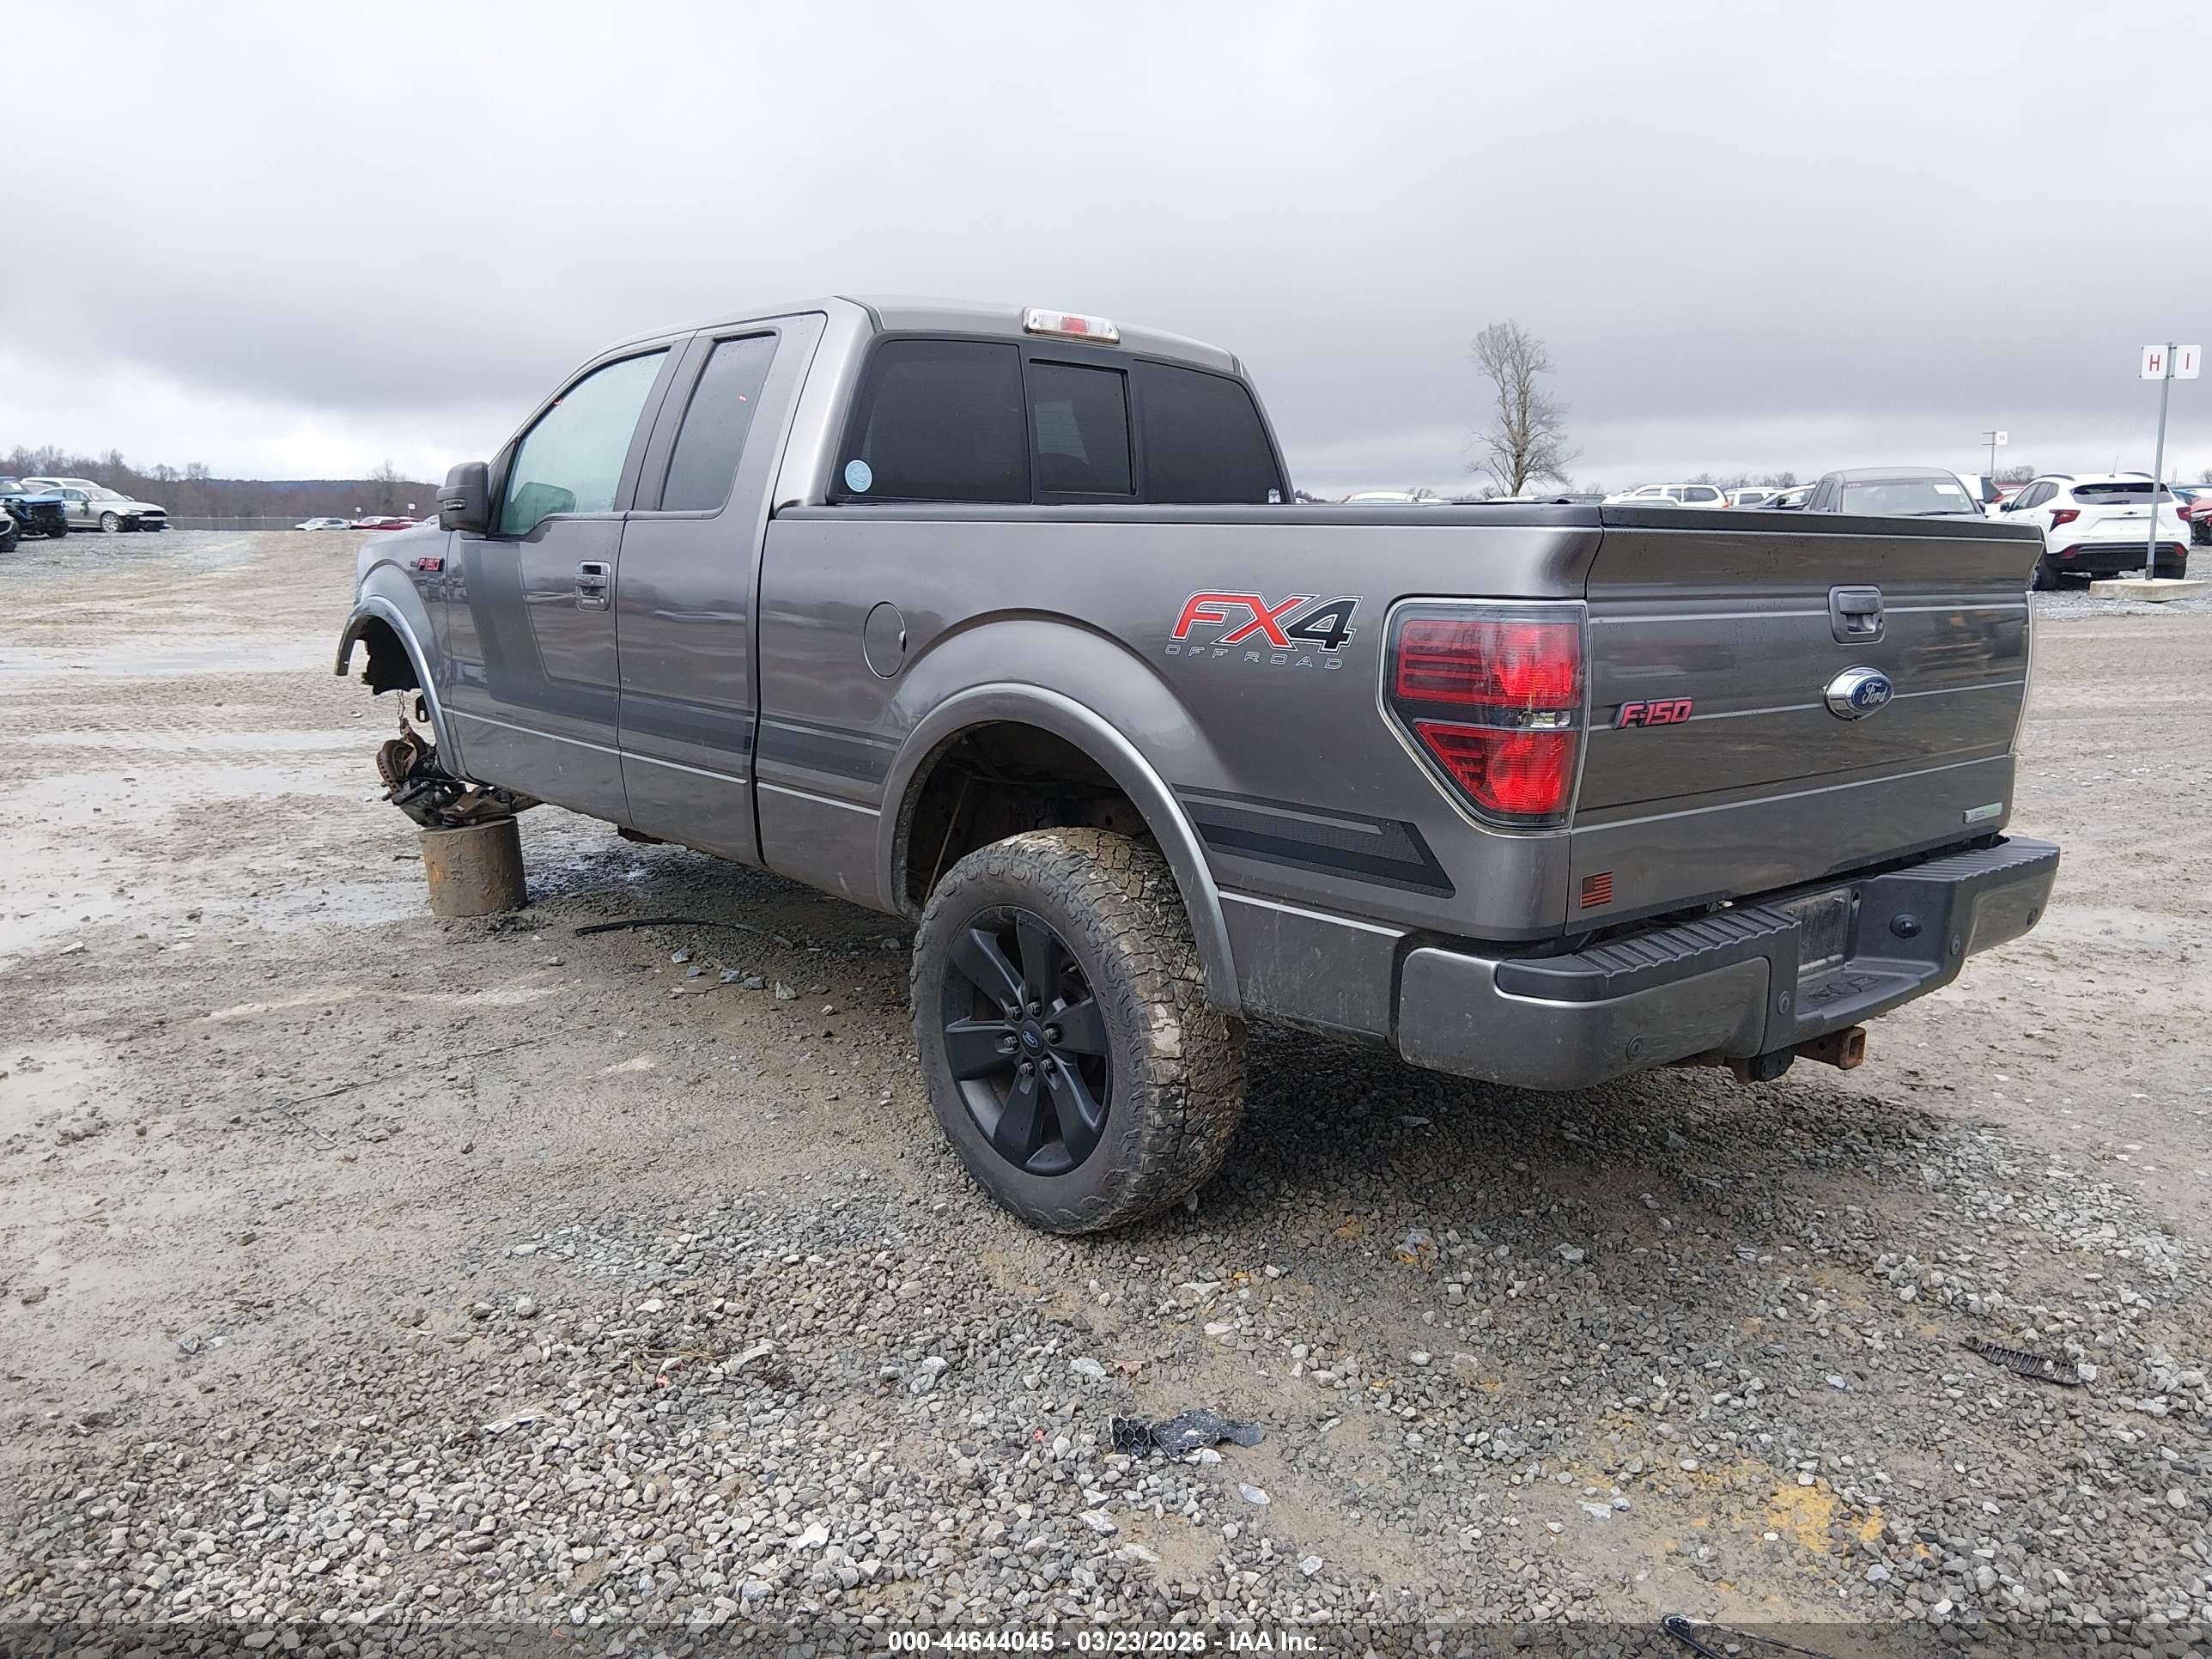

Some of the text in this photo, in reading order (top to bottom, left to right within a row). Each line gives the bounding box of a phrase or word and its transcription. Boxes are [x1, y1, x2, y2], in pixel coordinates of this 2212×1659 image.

[2148, 354, 2160, 372] H
[1169, 589, 1364, 654] FX4
[1165, 644, 1344, 670] OFF ROAD
[1861, 682, 1888, 704] Ford
[1616, 697, 1693, 729] F-150
